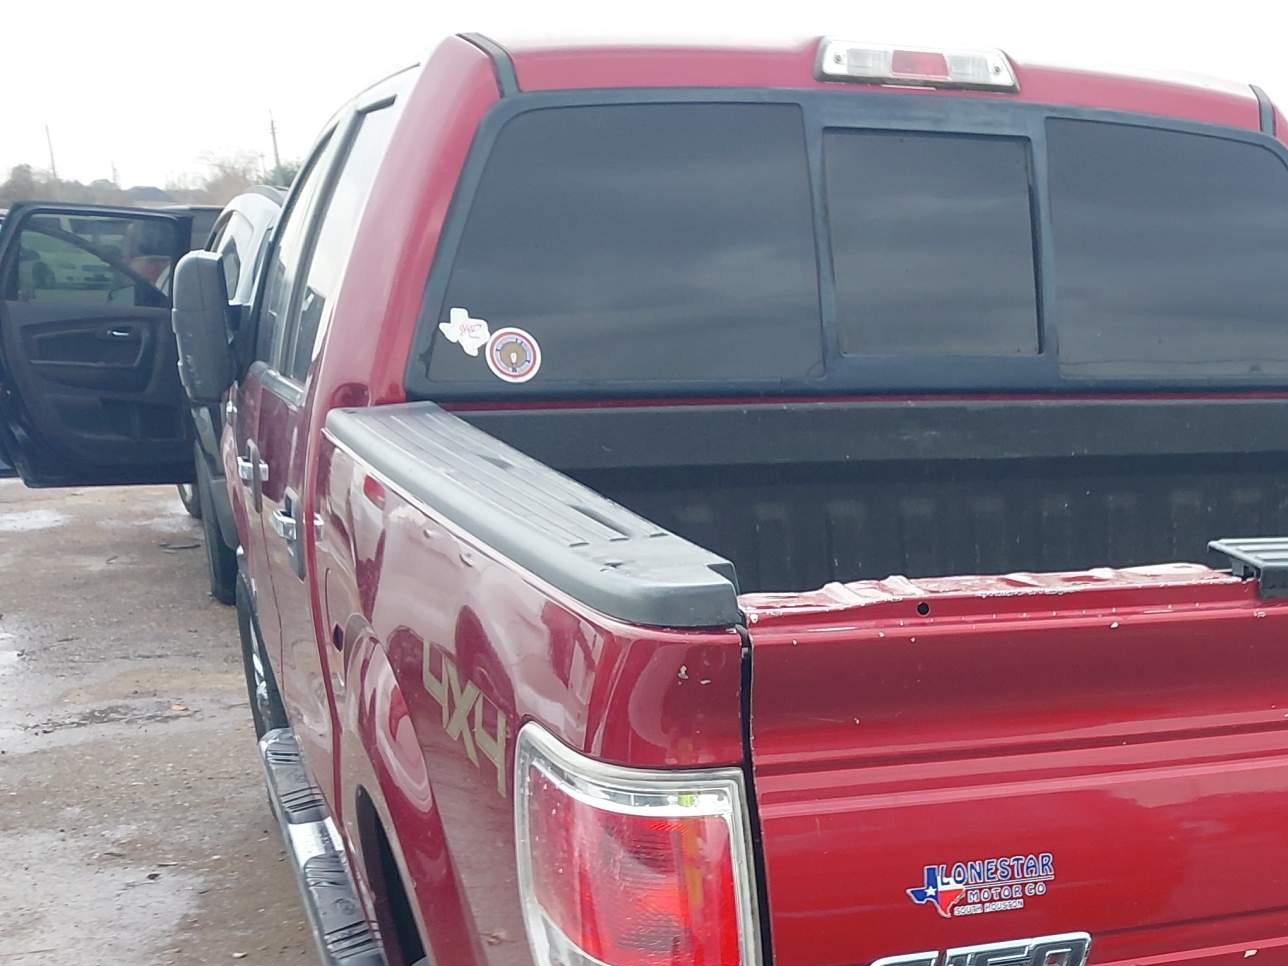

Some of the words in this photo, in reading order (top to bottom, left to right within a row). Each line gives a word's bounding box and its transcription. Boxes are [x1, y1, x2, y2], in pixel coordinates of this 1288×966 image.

[938, 853, 1054, 886] LONESTAR
[967, 886, 1023, 903] MOTOR
[1025, 882, 1047, 897] CO
